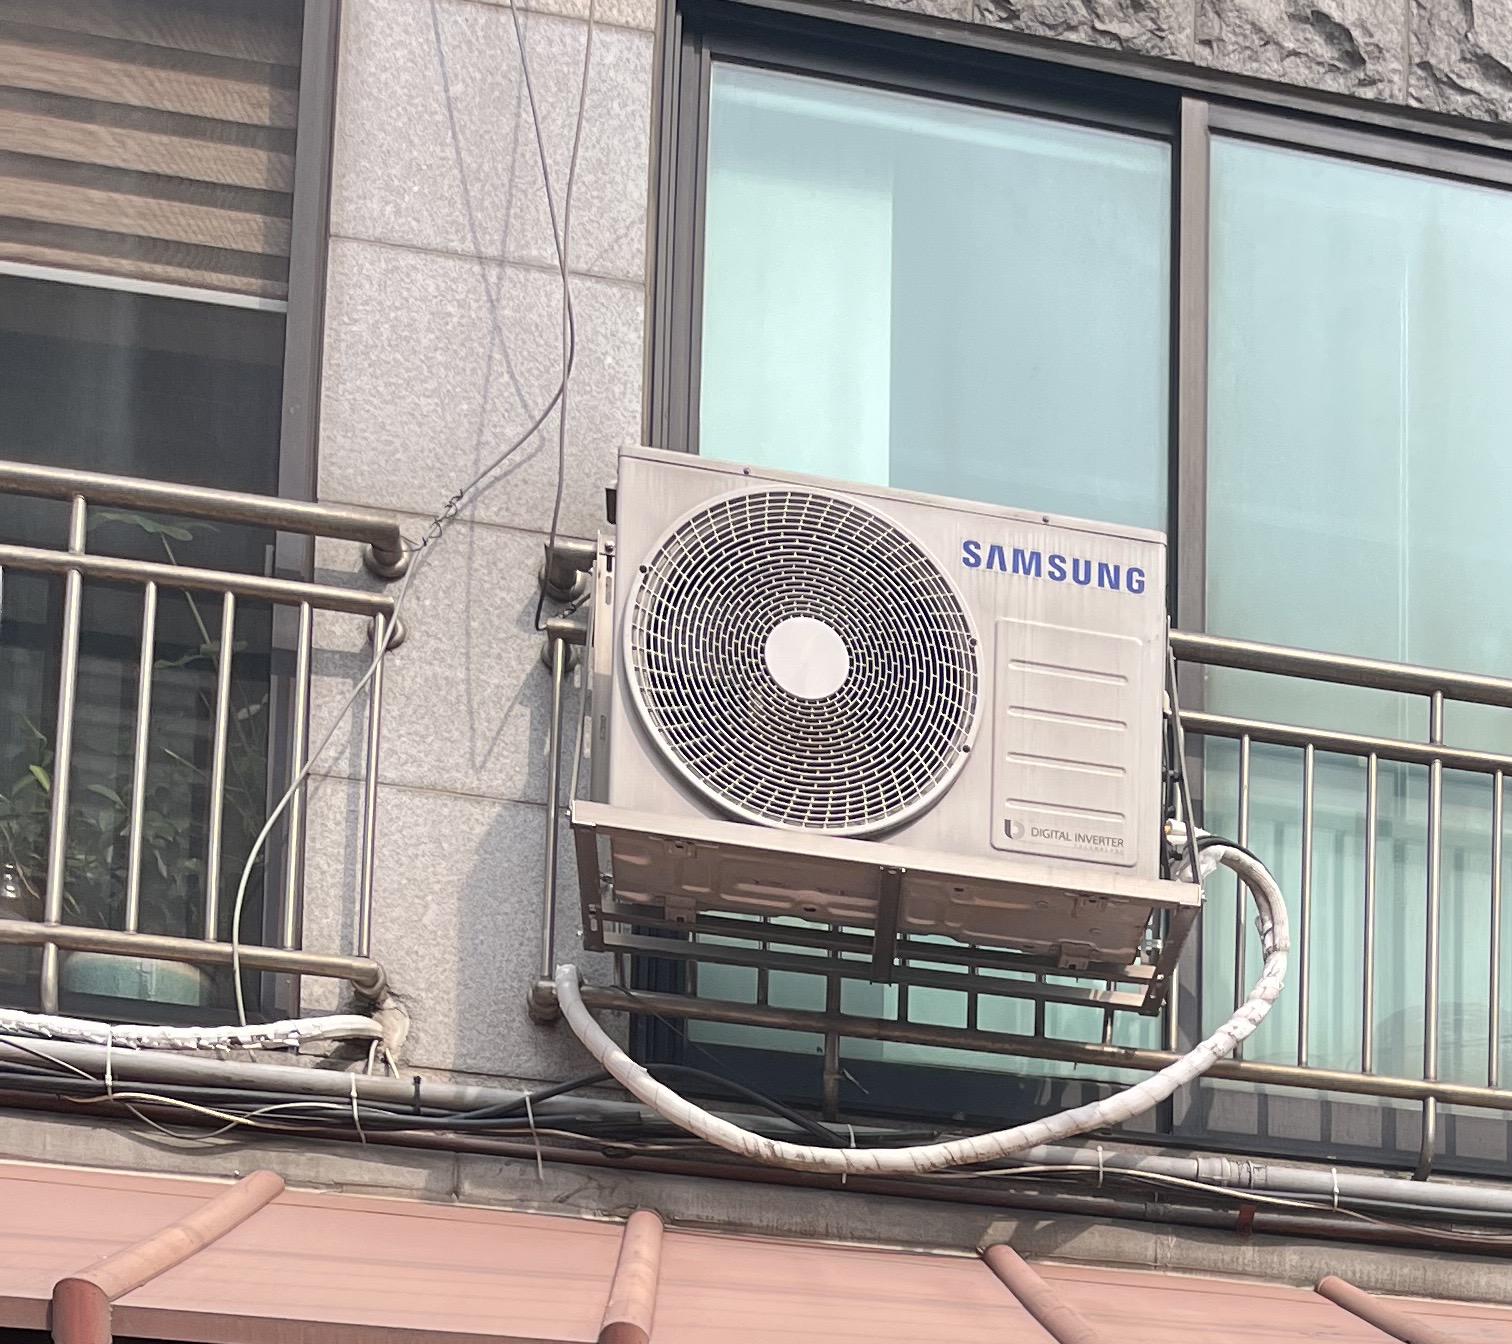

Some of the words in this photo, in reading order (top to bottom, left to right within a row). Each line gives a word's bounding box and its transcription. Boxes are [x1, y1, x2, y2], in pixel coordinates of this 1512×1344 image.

[961, 539, 1147, 595] SAMSUNG
[1031, 827, 1072, 842] DIGITAL
[1074, 832, 1124, 848] INVERTER
